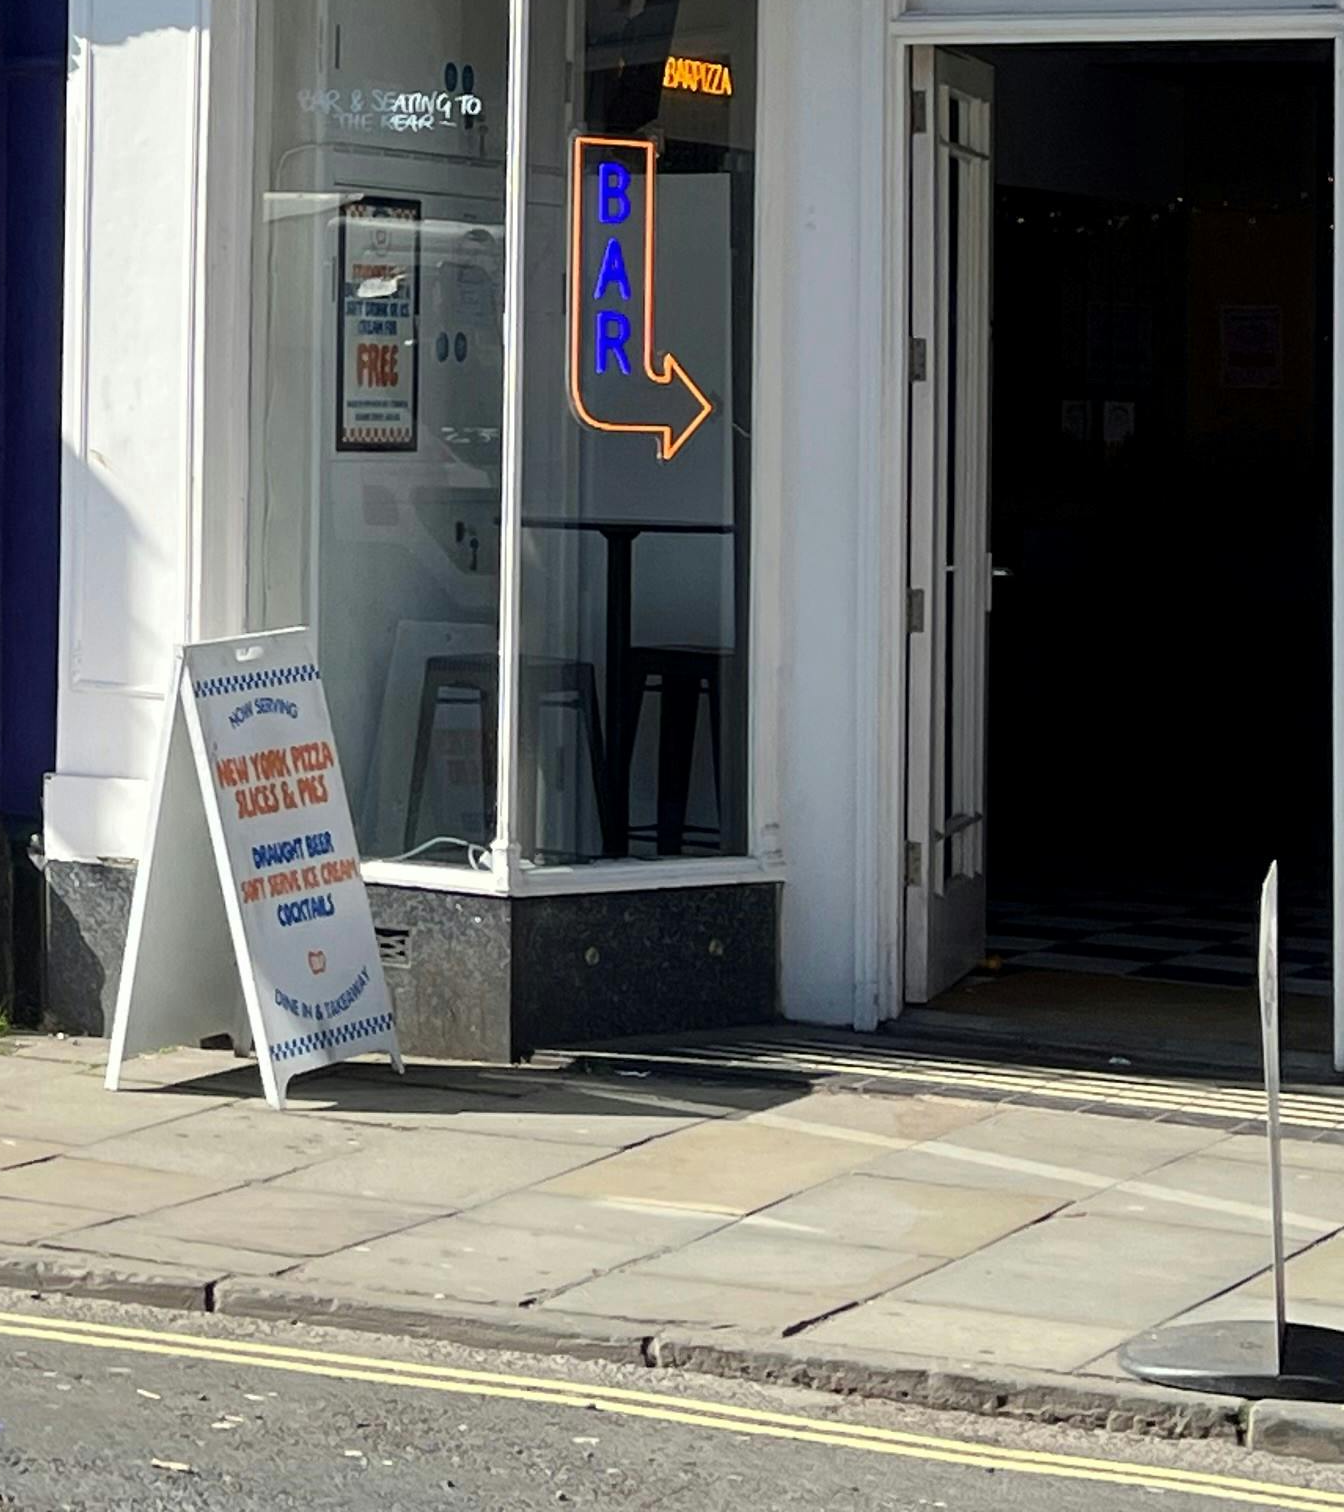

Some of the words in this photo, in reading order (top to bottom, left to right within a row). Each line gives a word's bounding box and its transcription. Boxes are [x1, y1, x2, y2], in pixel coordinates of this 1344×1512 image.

[333, 112, 374, 131] THE
[380, 112, 436, 133] REAR
[371, 88, 452, 120] SEATING
[454, 93, 482, 116] TO
[593, 160, 633, 376] BAR
[356, 342, 399, 389] FREE
[228, 701, 254, 729] NOW
[254, 696, 298, 720] SERVING
[216, 755, 250, 789] NEW
[250, 748, 291, 781] YORK
[290, 741, 334, 773] PIZZA
[235, 783, 280, 819] SLICES
[281, 780, 297, 810] &
[297, 773, 329, 807] PIES
[252, 837, 305, 869] DRAUGHT
[305, 831, 335, 858] BEER
[241, 876, 267, 904] SOFT
[267, 869, 301, 898] SERVE
[301, 864, 321, 890] ICE
[320, 857, 361, 886] CREAM
[276, 893, 335, 927] COCKTAILS
[274, 987, 299, 1017] DINE
[314, 1003, 324, 1021] &
[323, 965, 371, 1020] TAKEAWAY
